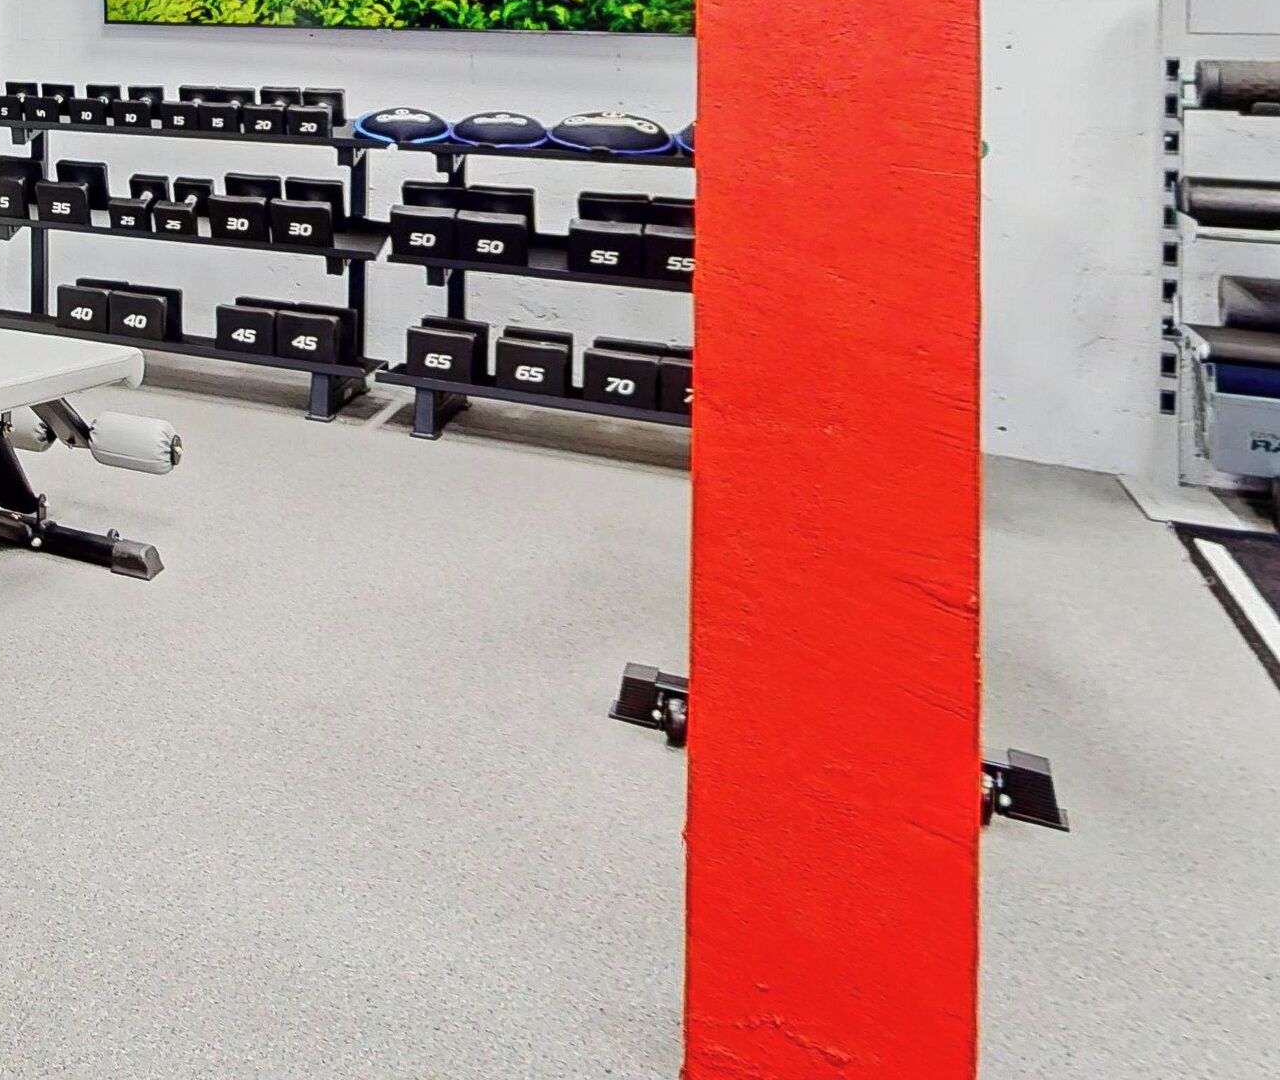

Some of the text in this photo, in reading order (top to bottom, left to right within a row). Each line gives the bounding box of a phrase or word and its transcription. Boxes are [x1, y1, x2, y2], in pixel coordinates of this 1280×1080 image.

[0, 107, 9, 116] 5
[81, 110, 93, 120] 10
[125, 113, 137, 123] 10
[173, 115, 185, 126] 15
[211, 117, 224, 128] 15
[254, 120, 272, 130] 20
[299, 122, 318, 133] 20
[51, 201, 71, 215] 35
[120, 215, 136, 226] 25
[164, 219, 182, 231] 25
[226, 217, 249, 231] 30
[288, 222, 313, 237] 30
[409, 232, 437, 248] 50
[476, 238, 505, 255] 50
[589, 250, 620, 265] 55
[666, 256, 696, 272] 55
[70, 306, 93, 321] 40
[122, 314, 148, 329] 40
[231, 328, 257, 344] 45
[291, 335, 318, 351] 45
[424, 352, 453, 370] 65
[513, 365, 546, 383] 65
[604, 376, 636, 396] 70
